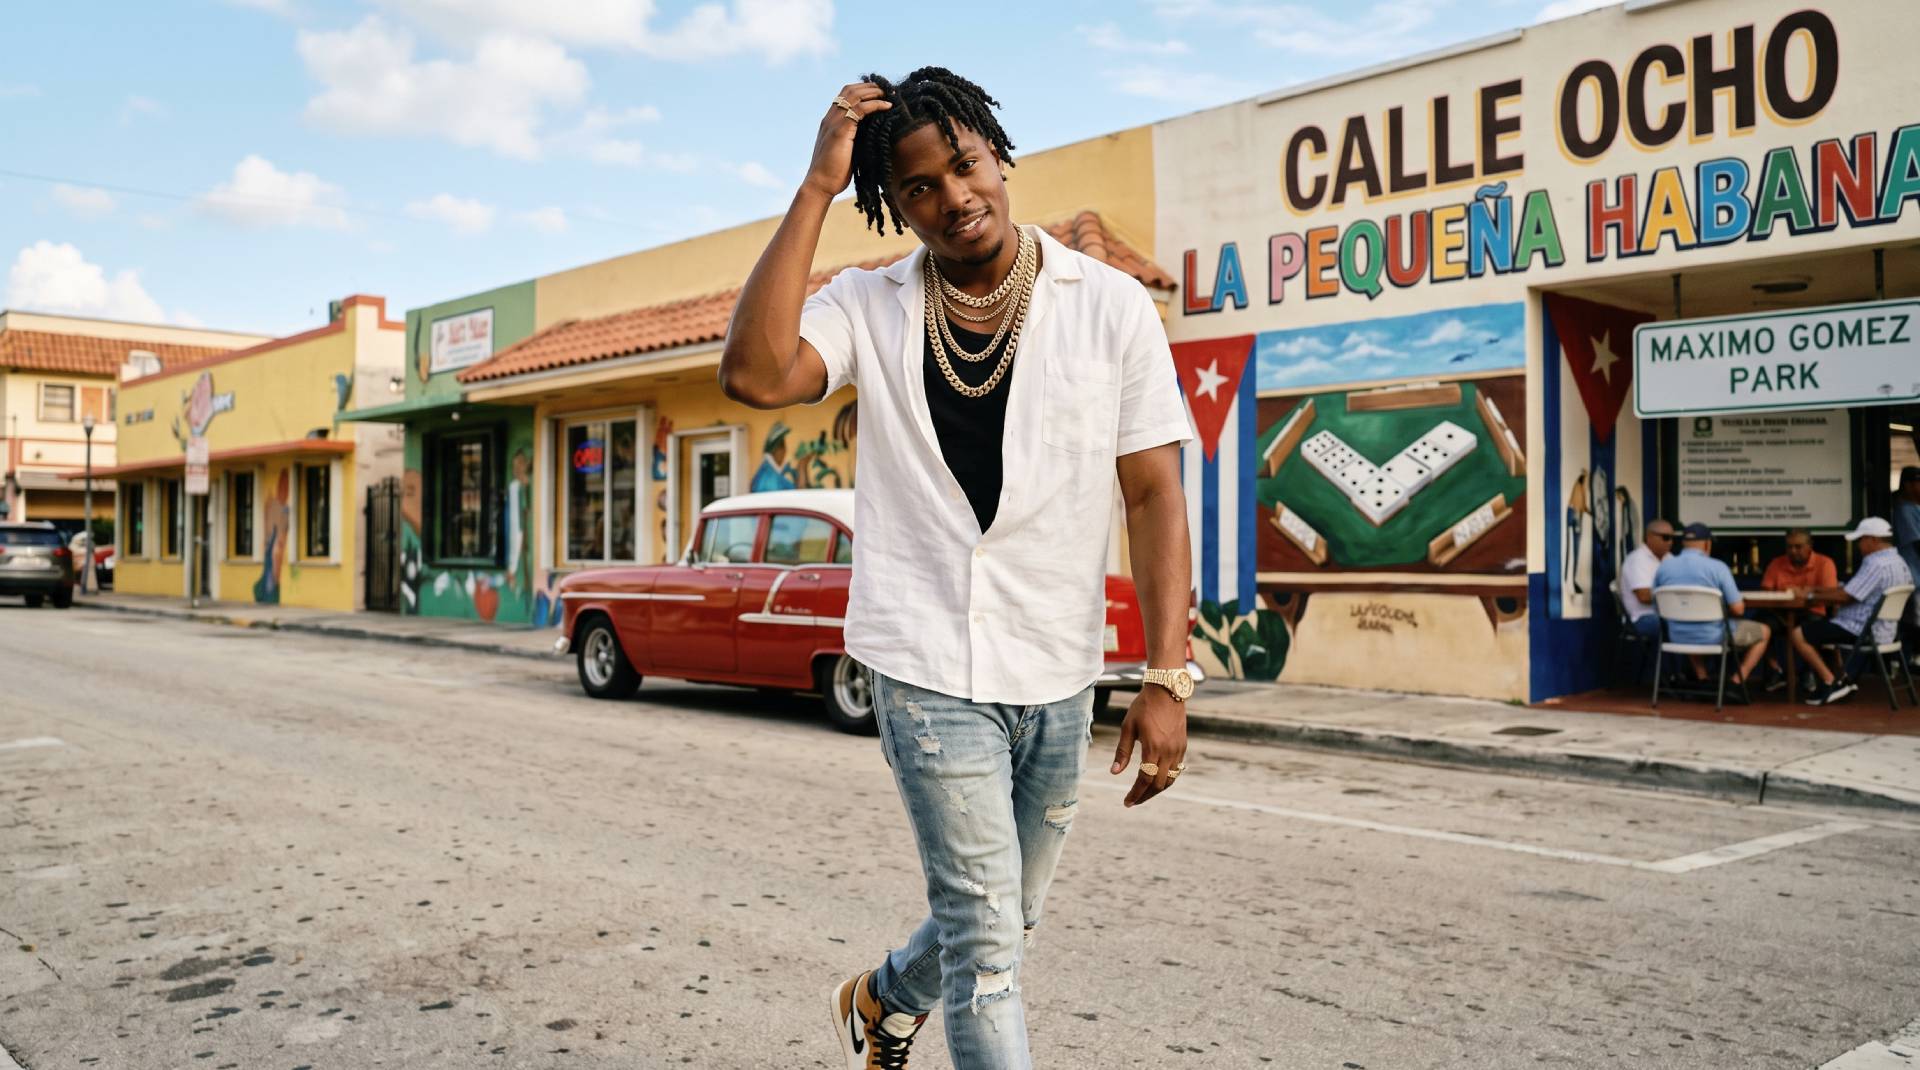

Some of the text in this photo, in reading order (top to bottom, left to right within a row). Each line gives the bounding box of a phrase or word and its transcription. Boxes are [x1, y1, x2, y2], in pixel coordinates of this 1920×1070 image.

[1282, 9, 1839, 213] CALLE OCHO
[1183, 242, 1248, 315] LA
[1269, 181, 1565, 305] PEQUEÑA
[1650, 315, 1911, 362] MAXIMO GOMEZ
[1730, 361, 1820, 394] PARK
